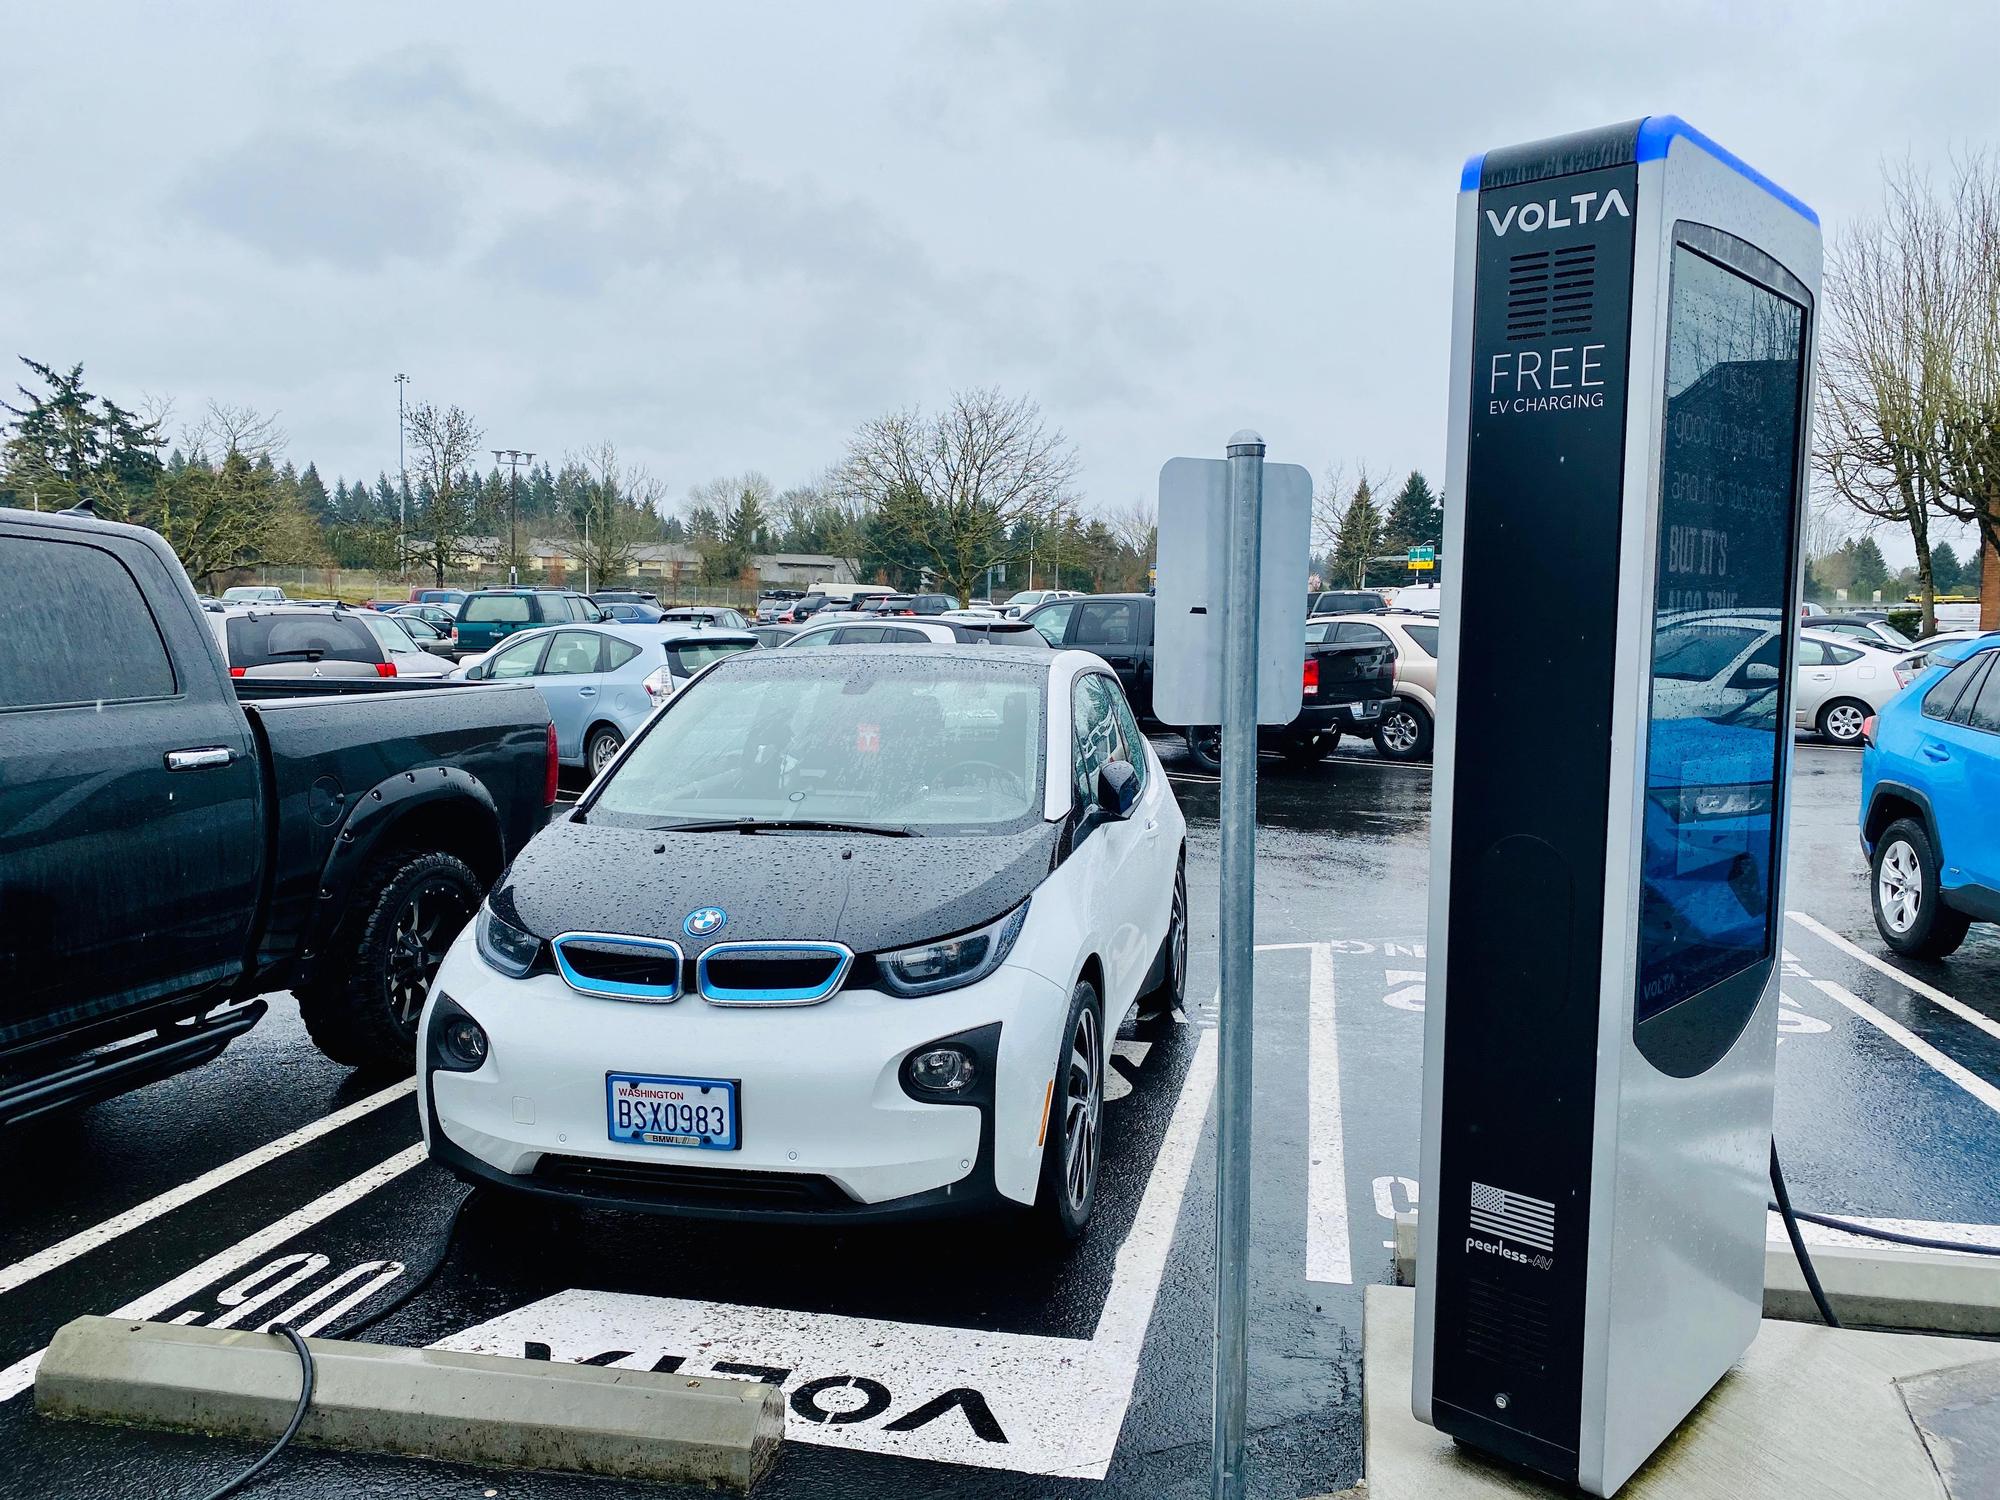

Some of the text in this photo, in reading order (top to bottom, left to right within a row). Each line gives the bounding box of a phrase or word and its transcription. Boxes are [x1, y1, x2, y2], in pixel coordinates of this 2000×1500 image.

[1486, 189, 1630, 237] VOLTA
[1491, 345, 1605, 393] FREE
[1490, 393, 1604, 414] EV CHARGING
[1669, 525, 1728, 576] BUT IT'S
[618, 1088, 684, 1100] WASHINGTON
[618, 1100, 724, 1136] BSX0983
